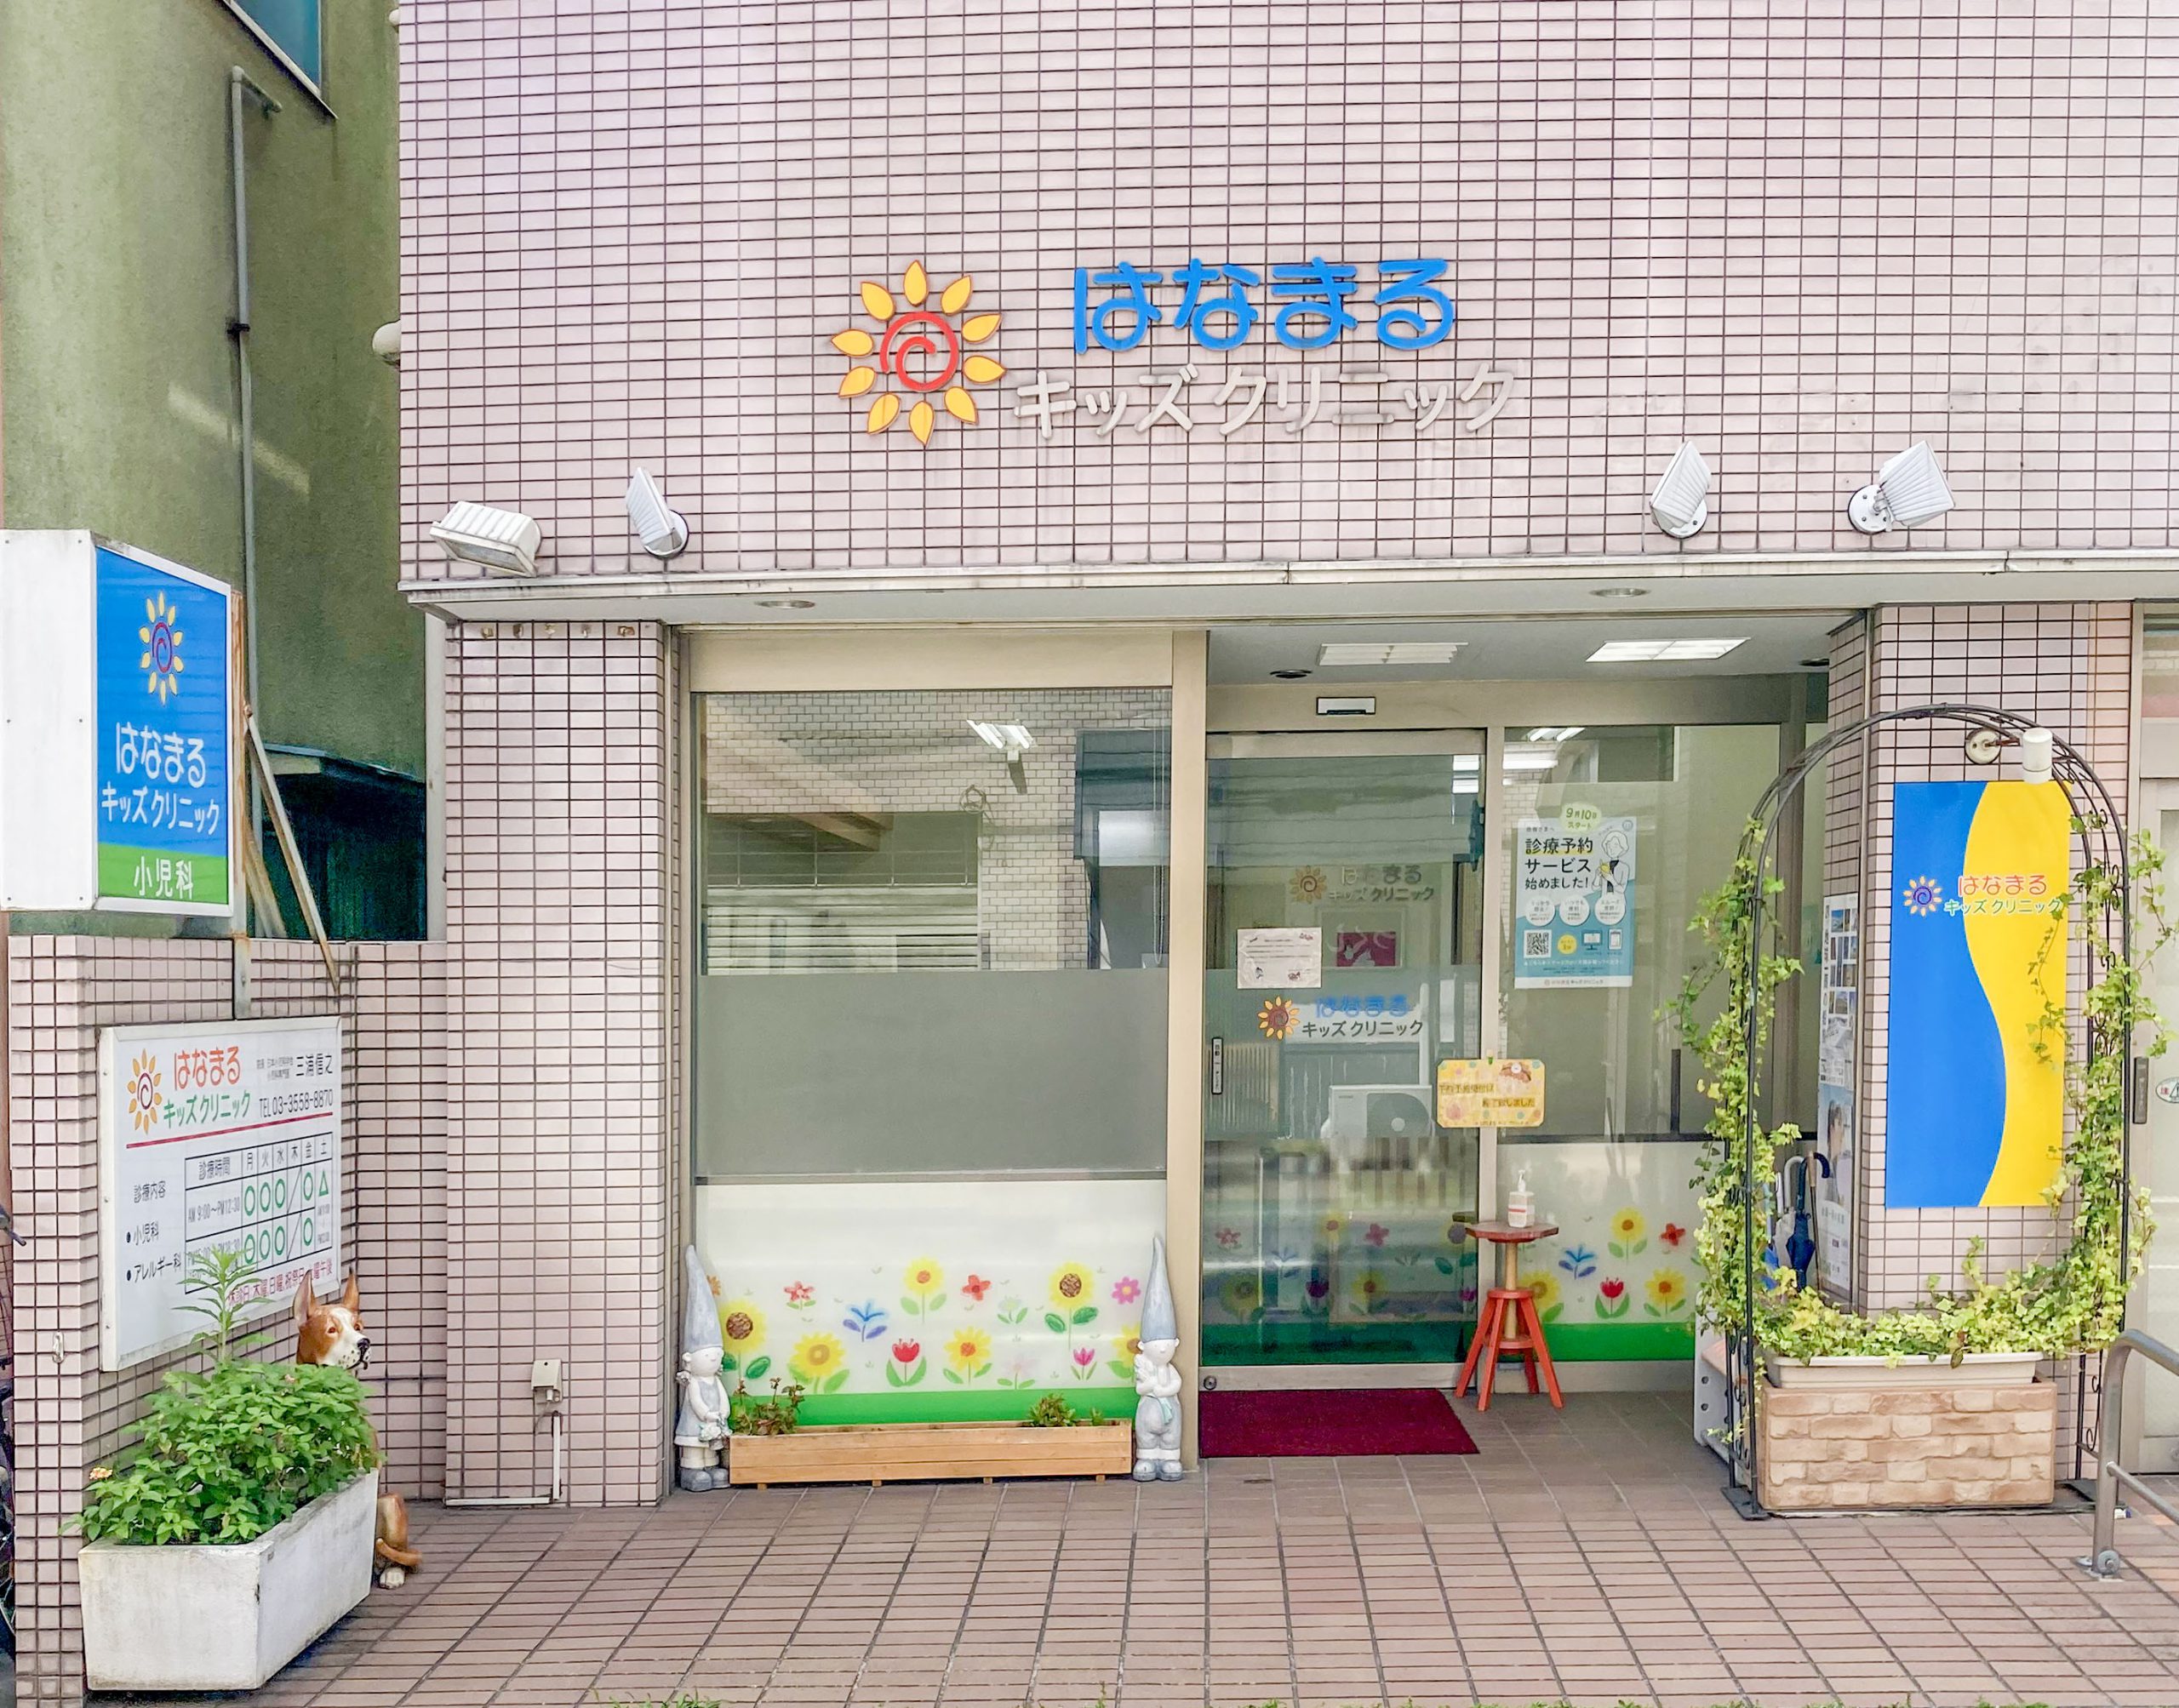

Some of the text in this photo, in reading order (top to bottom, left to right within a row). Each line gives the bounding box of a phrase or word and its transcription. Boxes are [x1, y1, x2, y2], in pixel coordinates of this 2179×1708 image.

[1075, 257, 1455, 354] はなまる
[1014, 363, 1515, 439] キッズクリニック
[116, 722, 207, 788] はなまる
[101, 780, 220, 835] キッズクリニック
[1525, 837, 1593, 854] 診療予約
[133, 855, 194, 900] 小児科
[1524, 857, 1591, 874] サービス
[1959, 875, 2047, 896] はなまる
[1945, 898, 2062, 915] キッズクリニック
[1301, 1020, 1423, 1037] キッズクリニック
[174, 1046, 241, 1091] はなまる
[163, 1090, 251, 1129] キッズクリニック
[247, 1151, 254, 1170] 月
[277, 1146, 284, 1165] 水
[291, 1145, 299, 1159] 木
[320, 1141, 327, 1156] 土
[134, 1180, 166, 1203] 診療内容
[133, 1220, 159, 1246] 小児科
[134, 1253, 182, 1283] アレルギー科
